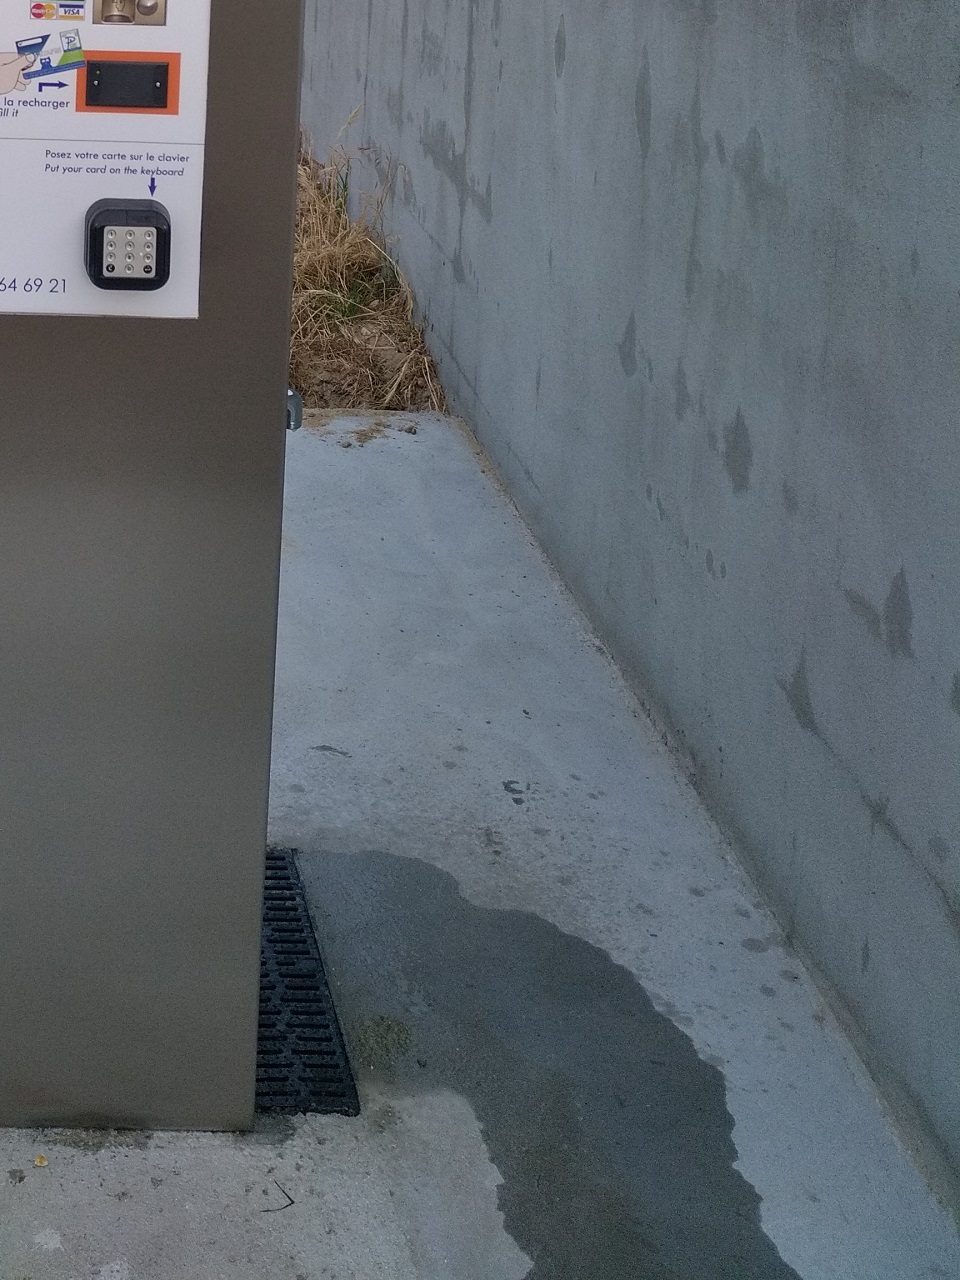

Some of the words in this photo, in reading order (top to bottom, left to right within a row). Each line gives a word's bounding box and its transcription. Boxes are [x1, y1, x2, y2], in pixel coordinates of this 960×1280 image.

[63, 8, 80, 16] VISA
[3, 96, 14, 107] la
[17, 97, 70, 110] recharger
[12, 108, 19, 118] it
[45, 149, 72, 159] Posez
[74, 151, 99, 160] votre
[101, 152, 127, 161] carte
[129, 153, 144, 162] sur
[146, 152, 155, 162] le
[157, 153, 190, 163] clavier
[44, 163, 59, 173] Put
[61, 165, 83, 175] your
[85, 165, 107, 174] card
[109, 167, 121, 175] on
[123, 166, 138, 175] the
[140, 166, 185, 177] keyboard
[23, 277, 43, 293] 69
[49, 278, 67, 293] 21
